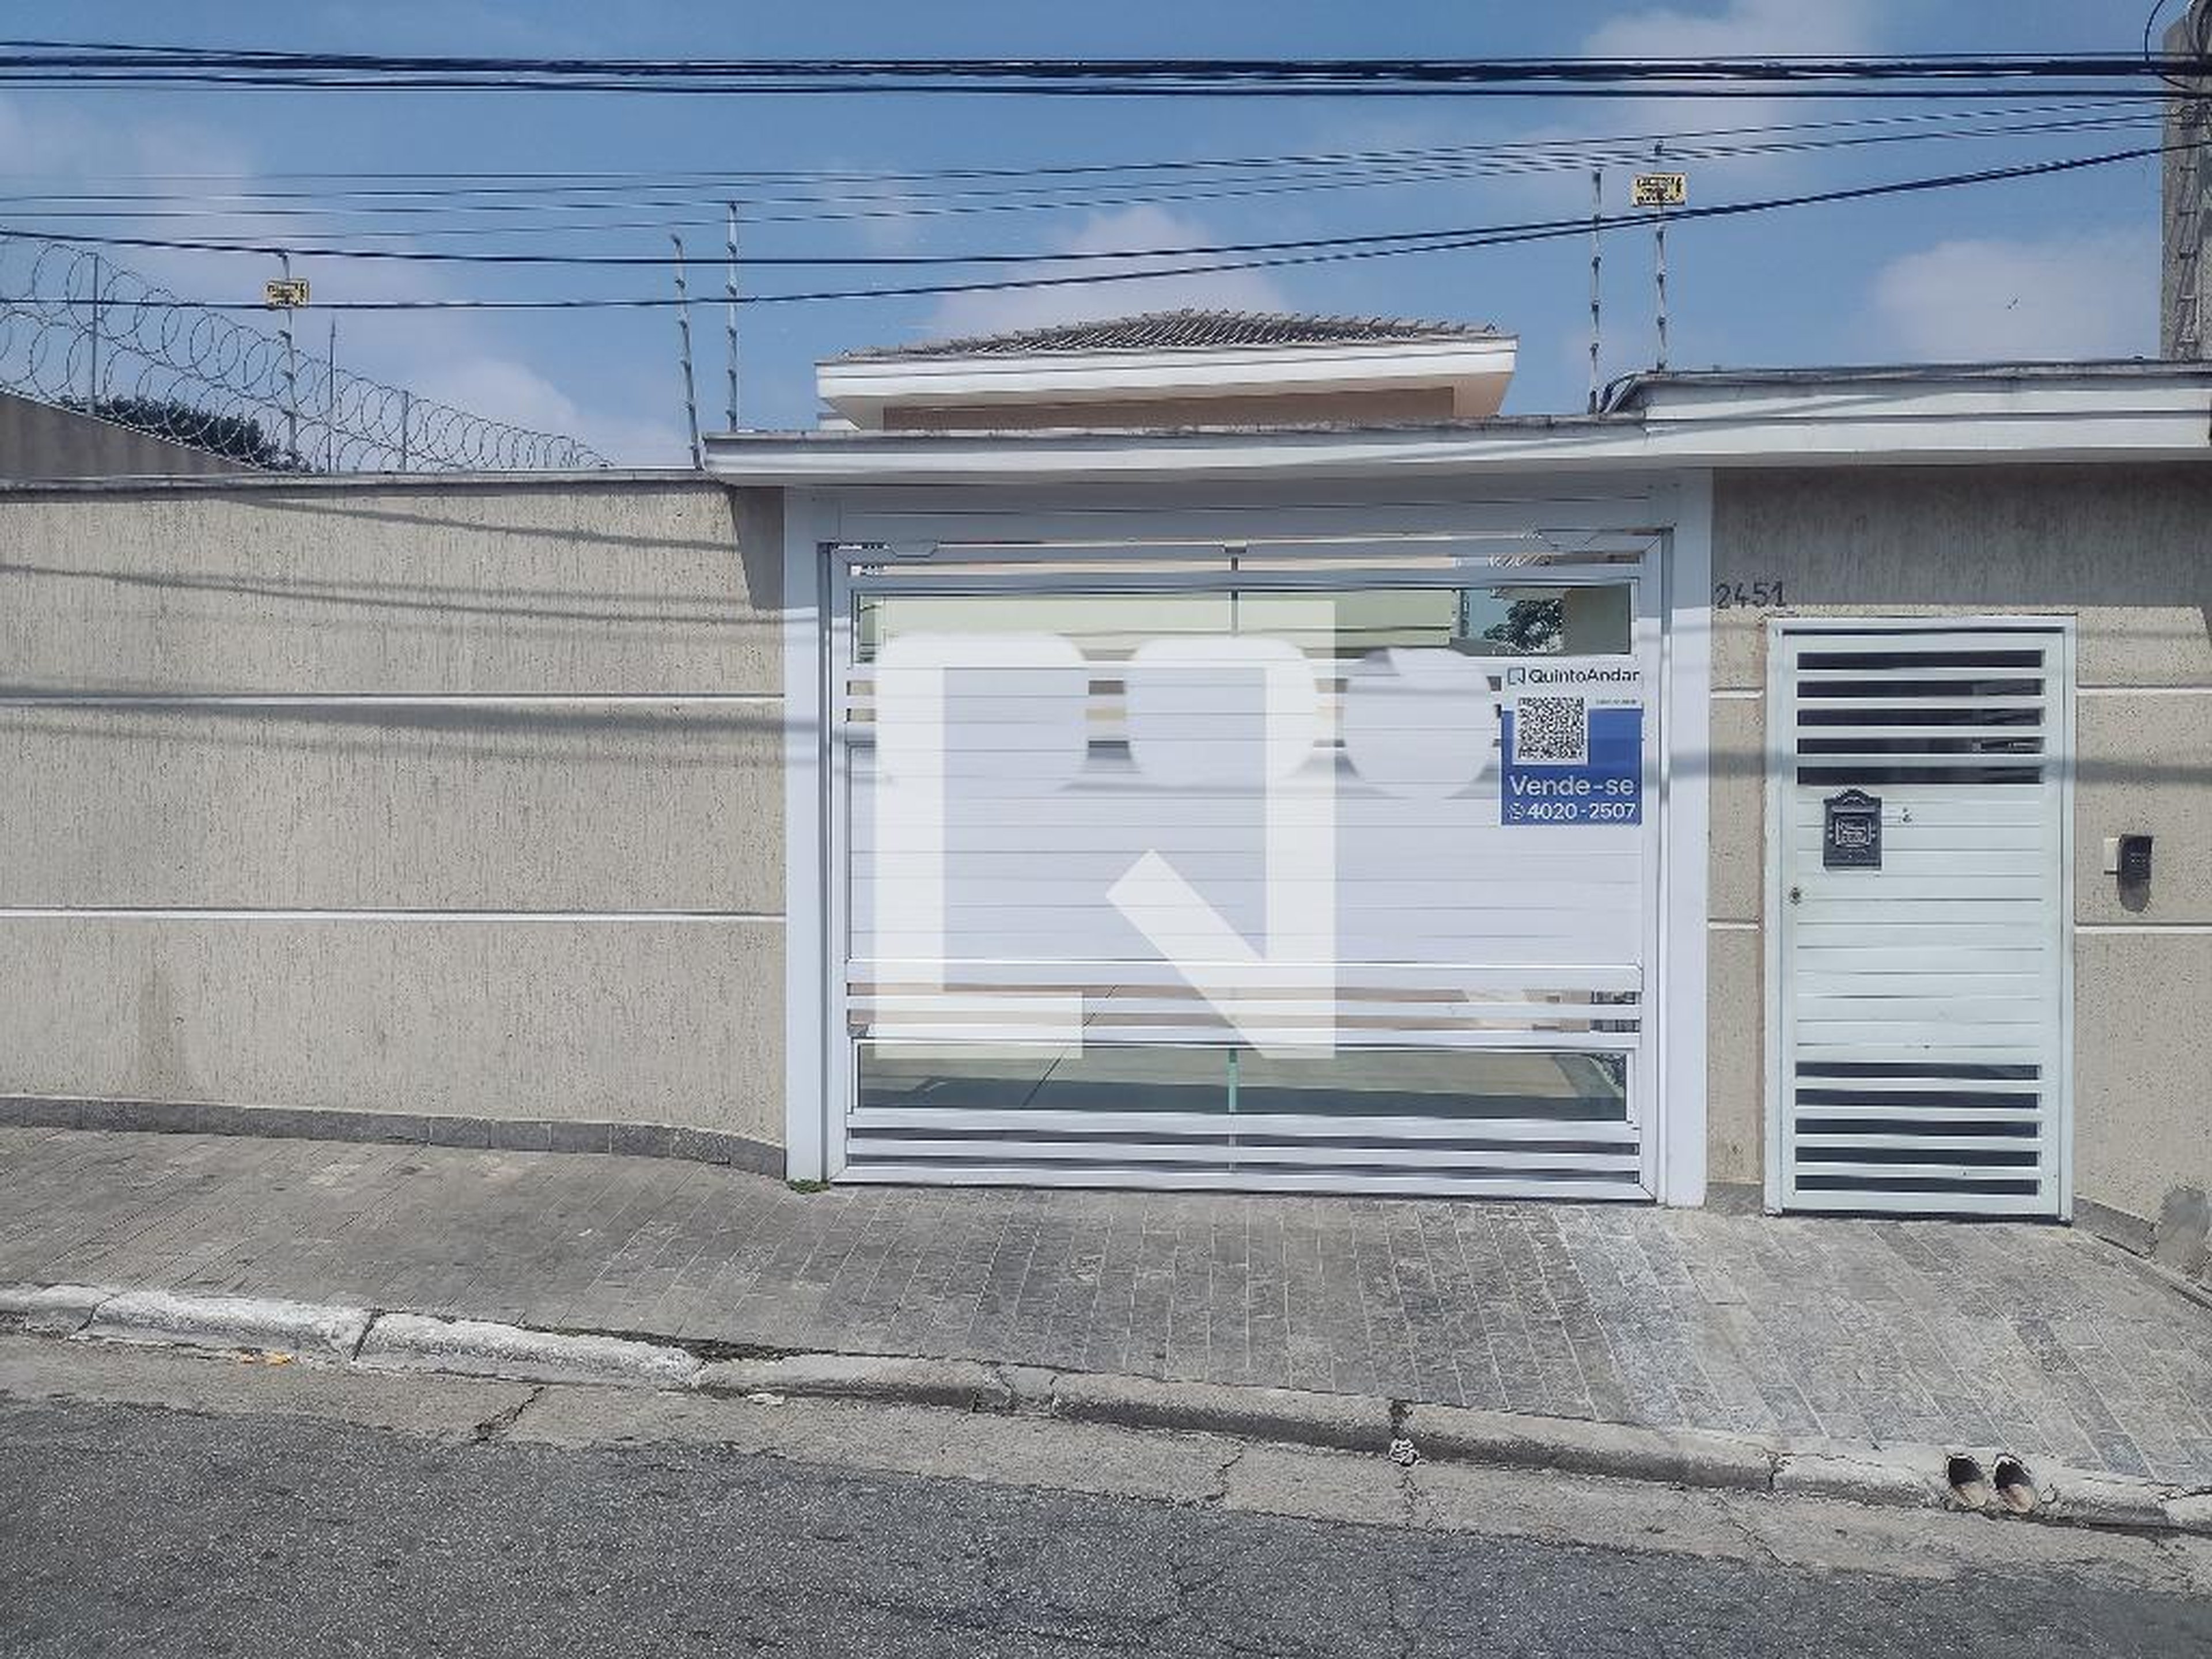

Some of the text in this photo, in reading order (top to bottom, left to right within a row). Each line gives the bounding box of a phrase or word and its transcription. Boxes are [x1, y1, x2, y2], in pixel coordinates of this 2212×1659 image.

[1715, 581, 1787, 609] 2451
[1528, 668, 1640, 683] QuintoAndar
[1509, 775, 1634, 796] Vende-se
[1527, 802, 1636, 820] 4020-2507
